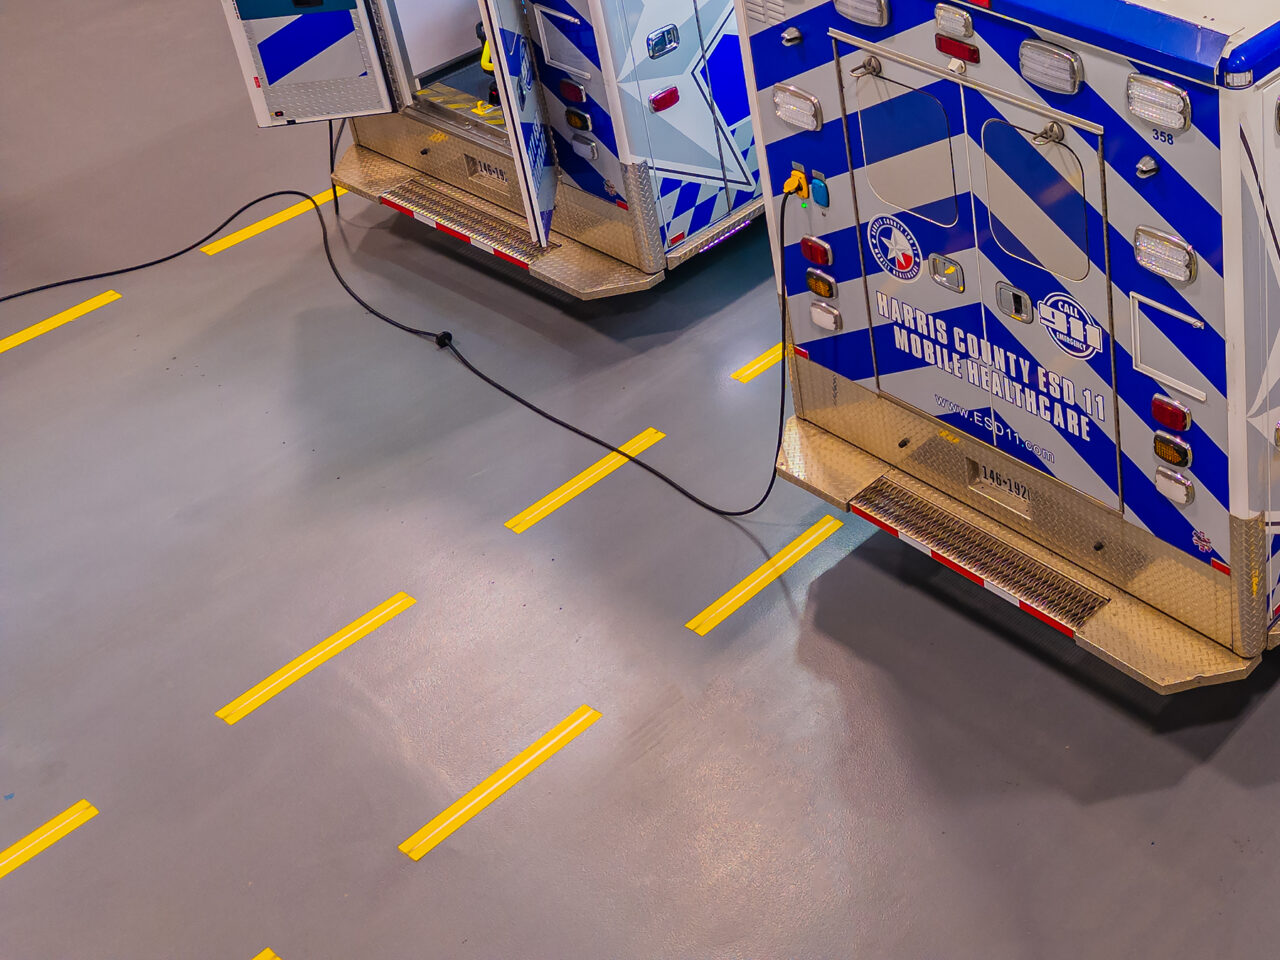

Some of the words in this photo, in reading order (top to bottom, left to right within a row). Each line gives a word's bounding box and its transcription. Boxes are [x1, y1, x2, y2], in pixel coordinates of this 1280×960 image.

[1152, 128, 1174, 146] 358
[1058, 301, 1080, 319] CALL
[876, 291, 949, 345] HARRIS
[953, 327, 1030, 383] COUNTY
[1038, 365, 1075, 406] ESD
[1083, 388, 1106, 422] 11
[893, 325, 963, 379] MOBILE
[967, 358, 1091, 442] HEALTHCARE
[934, 394, 1055, 463] www.ESD11.com
